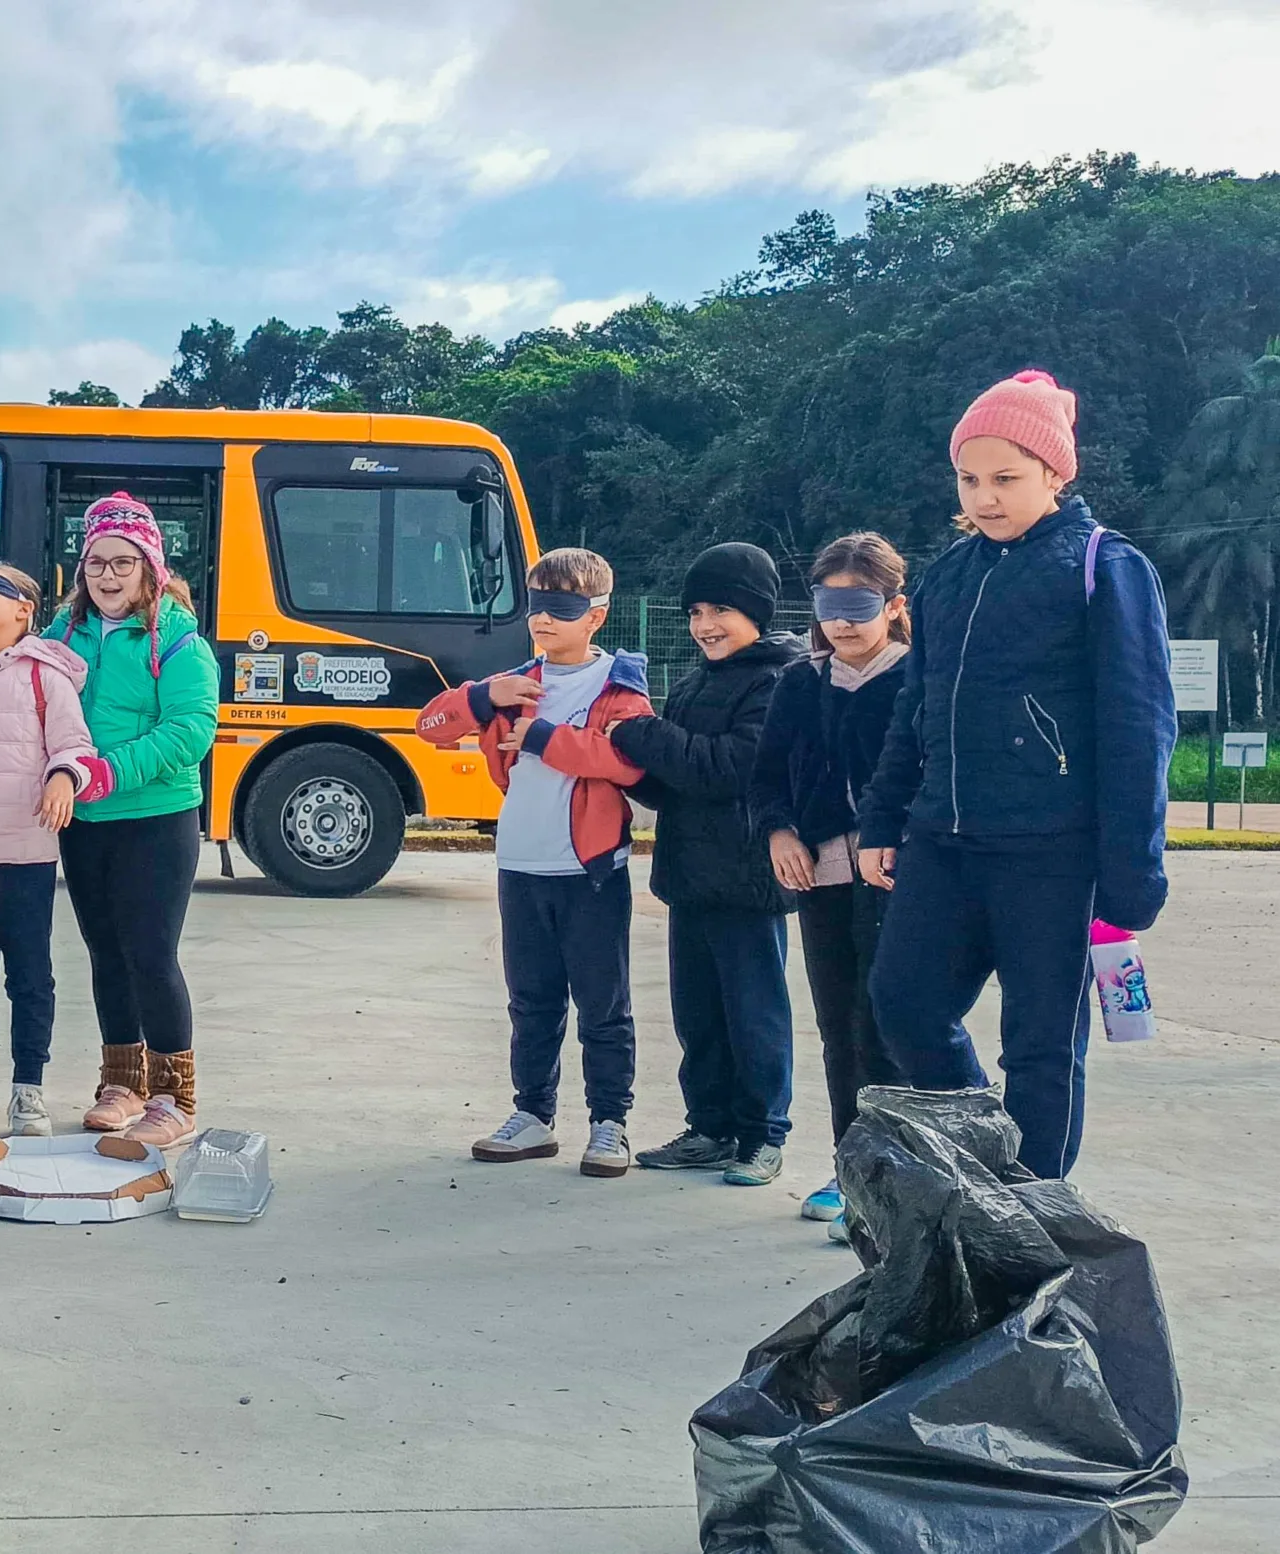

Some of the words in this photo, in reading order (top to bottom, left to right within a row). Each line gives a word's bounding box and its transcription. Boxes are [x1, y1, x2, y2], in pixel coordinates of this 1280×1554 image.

[323, 659, 369, 669] PREFEITURA
[370, 660, 383, 669] DE
[324, 669, 388, 684] RODEIO
[230, 709, 263, 719] DETER
[265, 710, 287, 720] 1914
[420, 712, 446, 731] GAMES
